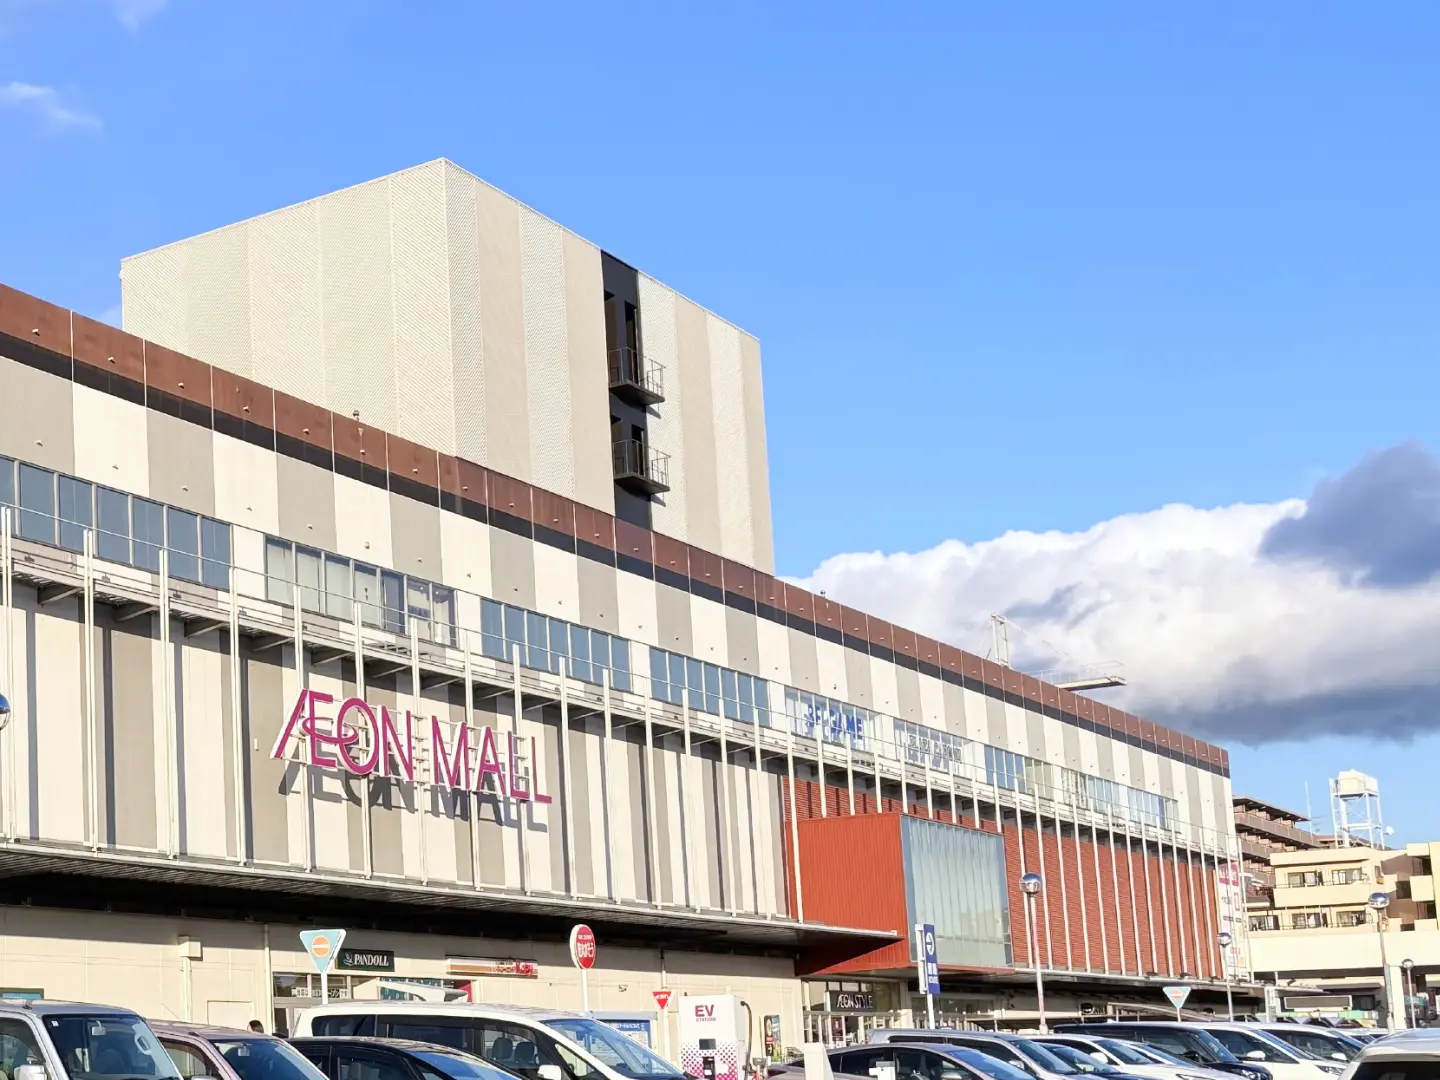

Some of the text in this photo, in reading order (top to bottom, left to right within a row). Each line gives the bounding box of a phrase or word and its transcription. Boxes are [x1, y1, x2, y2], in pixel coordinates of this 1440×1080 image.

[431, 714, 552, 804] MALL
[353, 953, 389, 967] PANDOLL
[855, 995, 873, 1009] STYLE
[695, 1004, 714, 1017] EV
